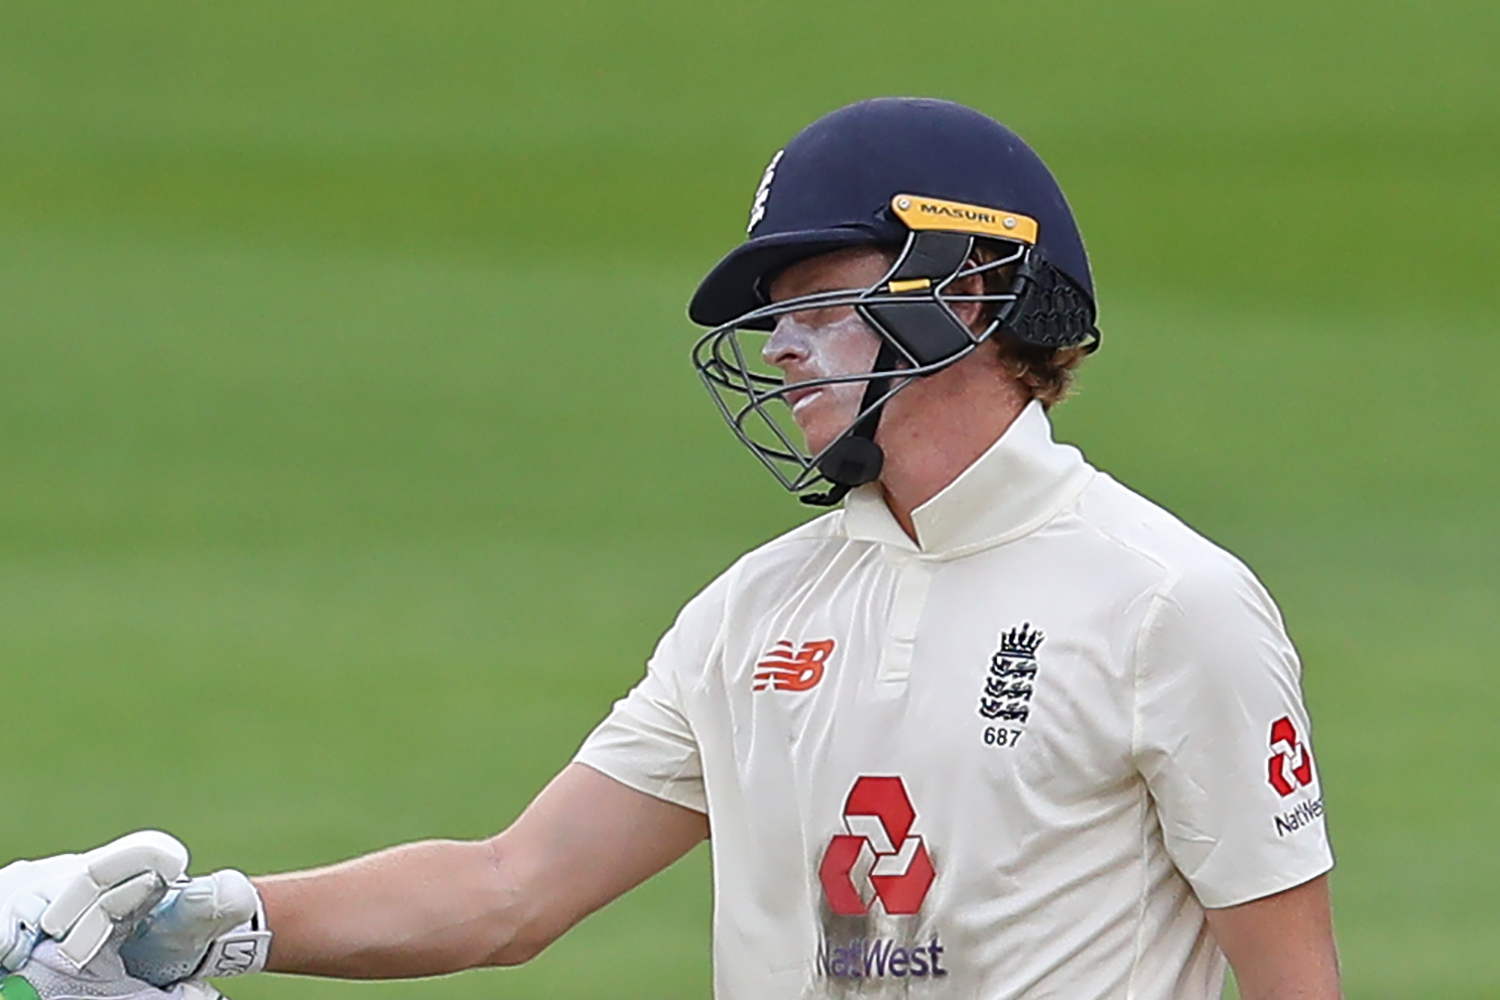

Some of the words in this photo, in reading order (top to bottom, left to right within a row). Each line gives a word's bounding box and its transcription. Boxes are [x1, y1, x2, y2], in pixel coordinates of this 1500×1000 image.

[921, 204, 997, 224] MASURI
[984, 726, 1022, 748] 687
[816, 936, 947, 977] NatWest
